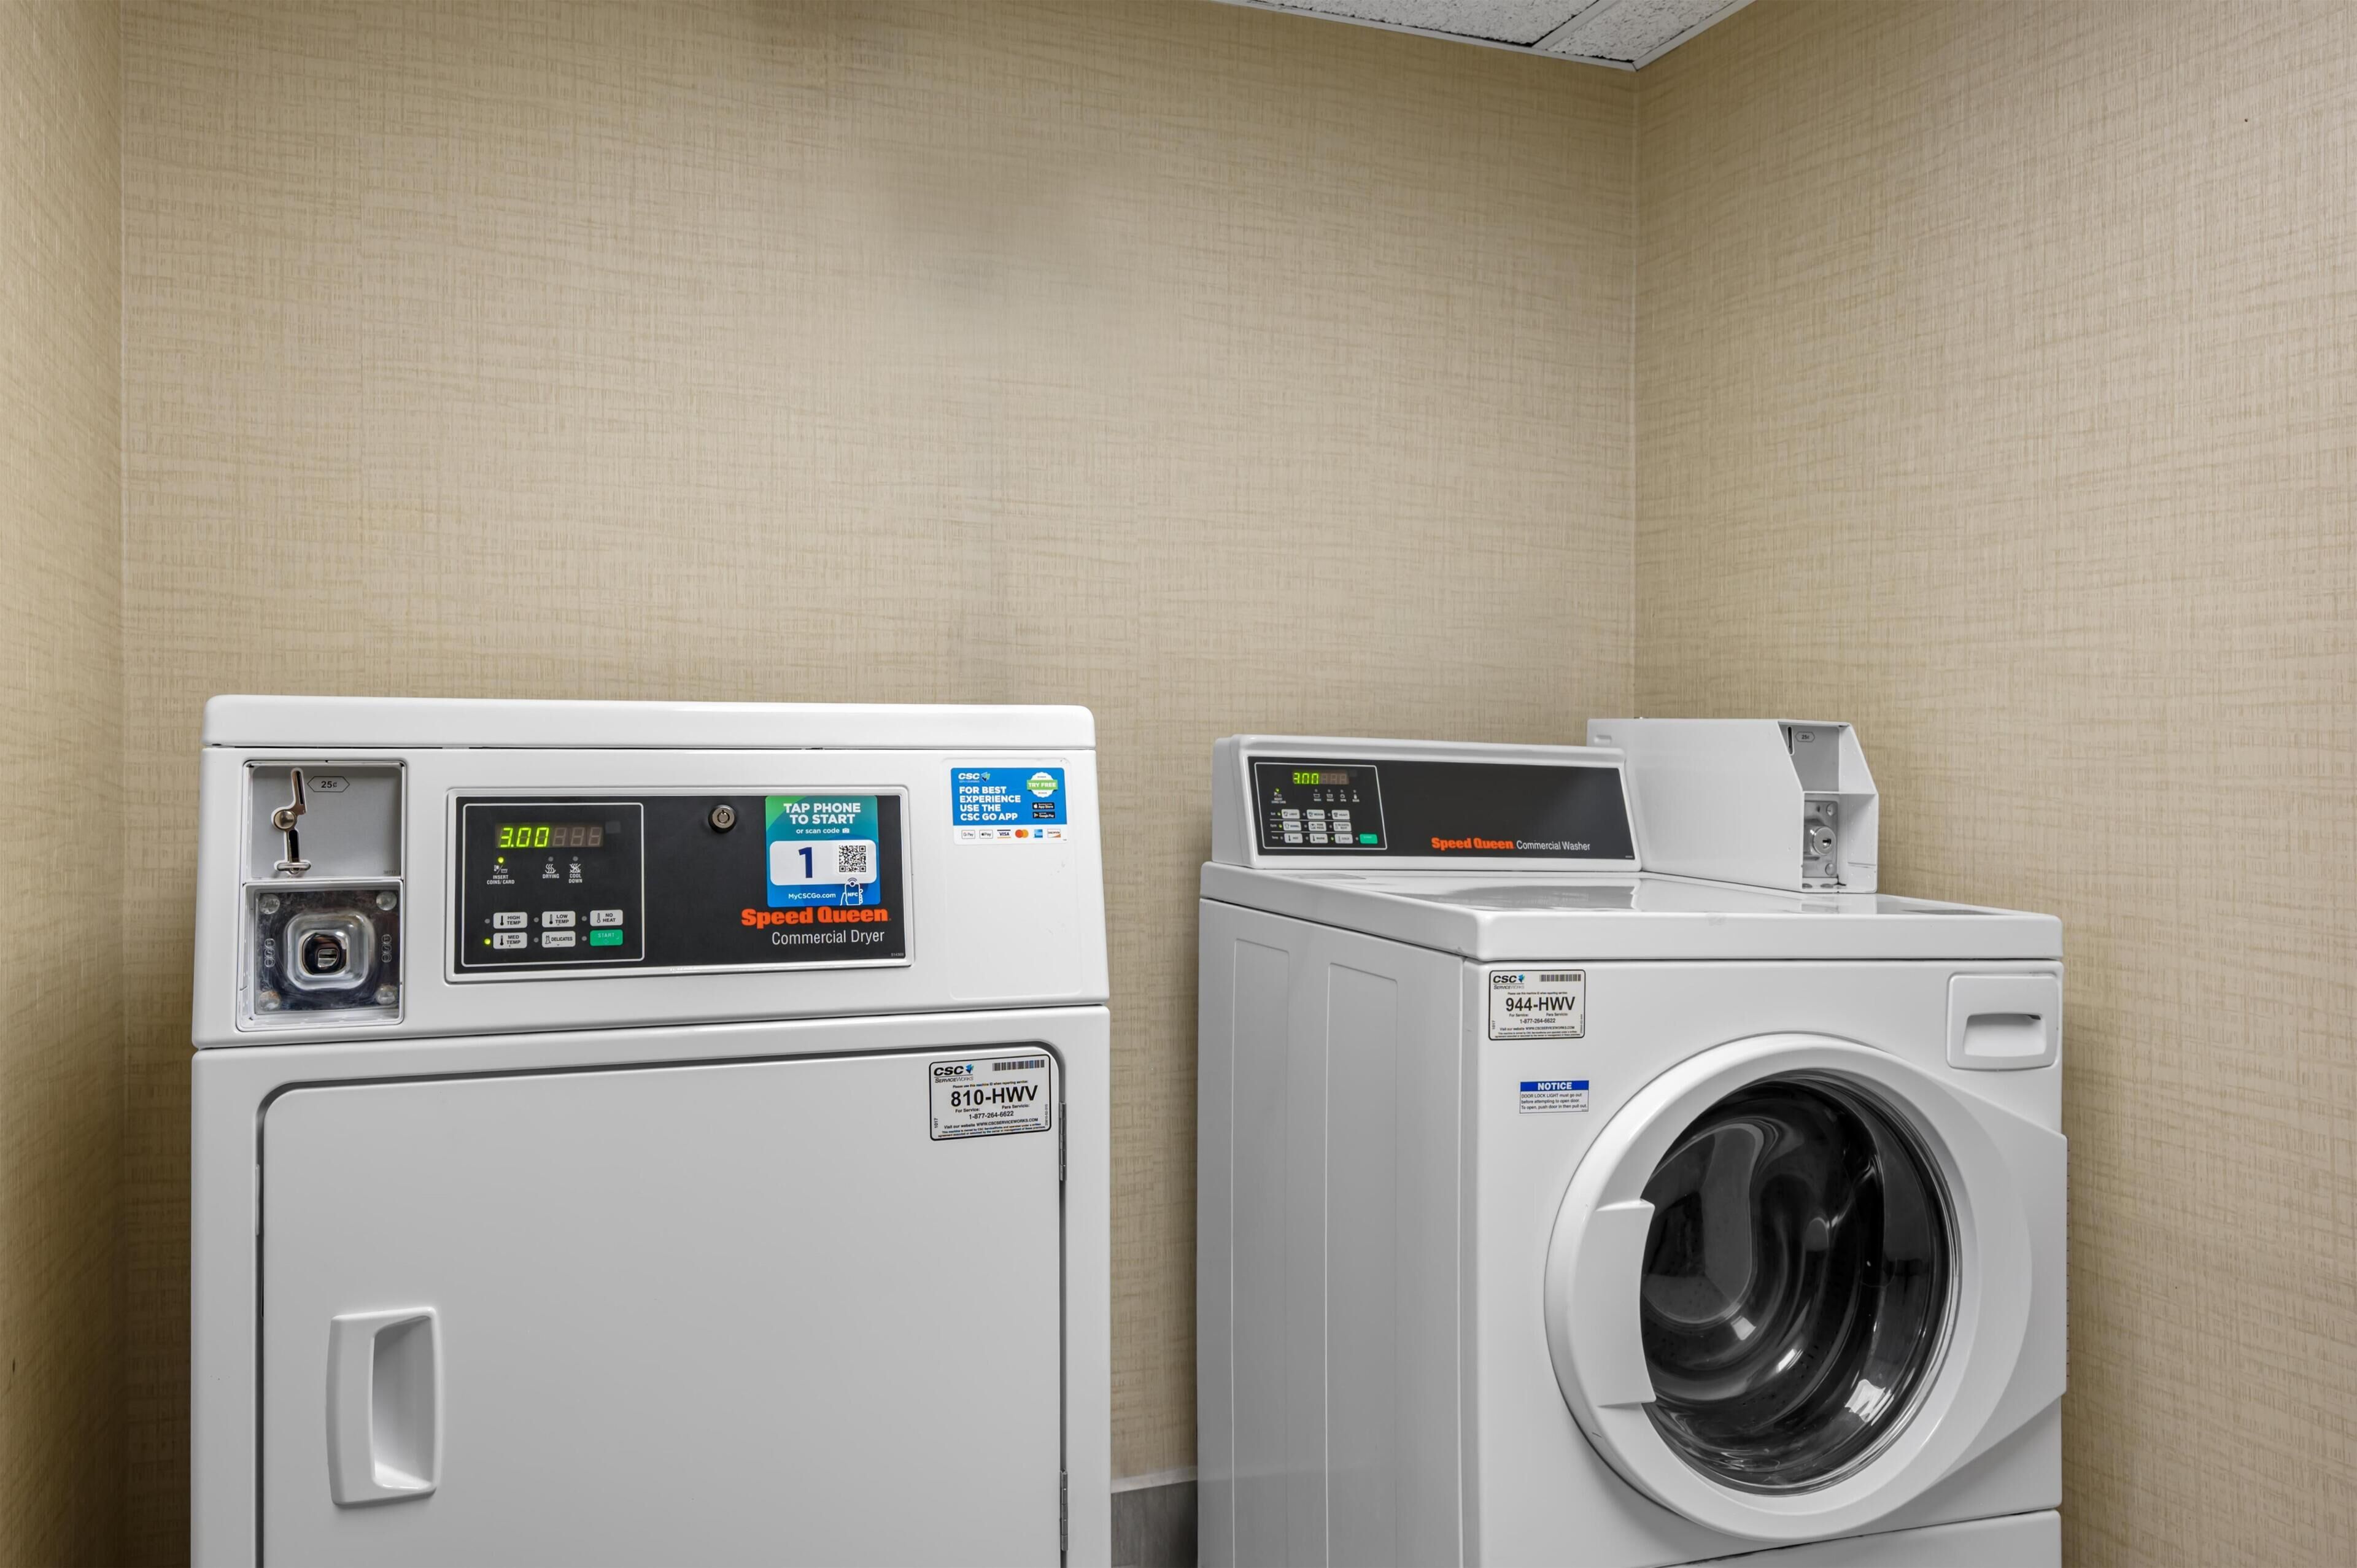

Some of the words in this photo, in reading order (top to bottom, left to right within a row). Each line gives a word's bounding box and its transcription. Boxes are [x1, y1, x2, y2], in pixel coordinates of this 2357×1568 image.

[783, 803, 810, 814] TAP
[814, 803, 861, 813] PHONE
[790, 814, 810, 824] TO
[812, 814, 855, 824] START
[500, 827, 549, 848] 3.00
[1431, 837, 1472, 851] Speed
[1473, 838, 1514, 849] Queen
[1516, 840, 1561, 850] Commercial
[1562, 841, 1590, 851] Washer
[798, 846, 813, 878] 1
[741, 907, 813, 929] Speed
[817, 906, 888, 924] Queen
[772, 930, 846, 945] Commercial
[851, 929, 884, 944] Dryer
[1506, 997, 1575, 1011] 944-HWV
[934, 1065, 964, 1076] CSC
[951, 1085, 1038, 1107] 810-HWV
[969, 1111, 1014, 1119] 1-877-264-6622
